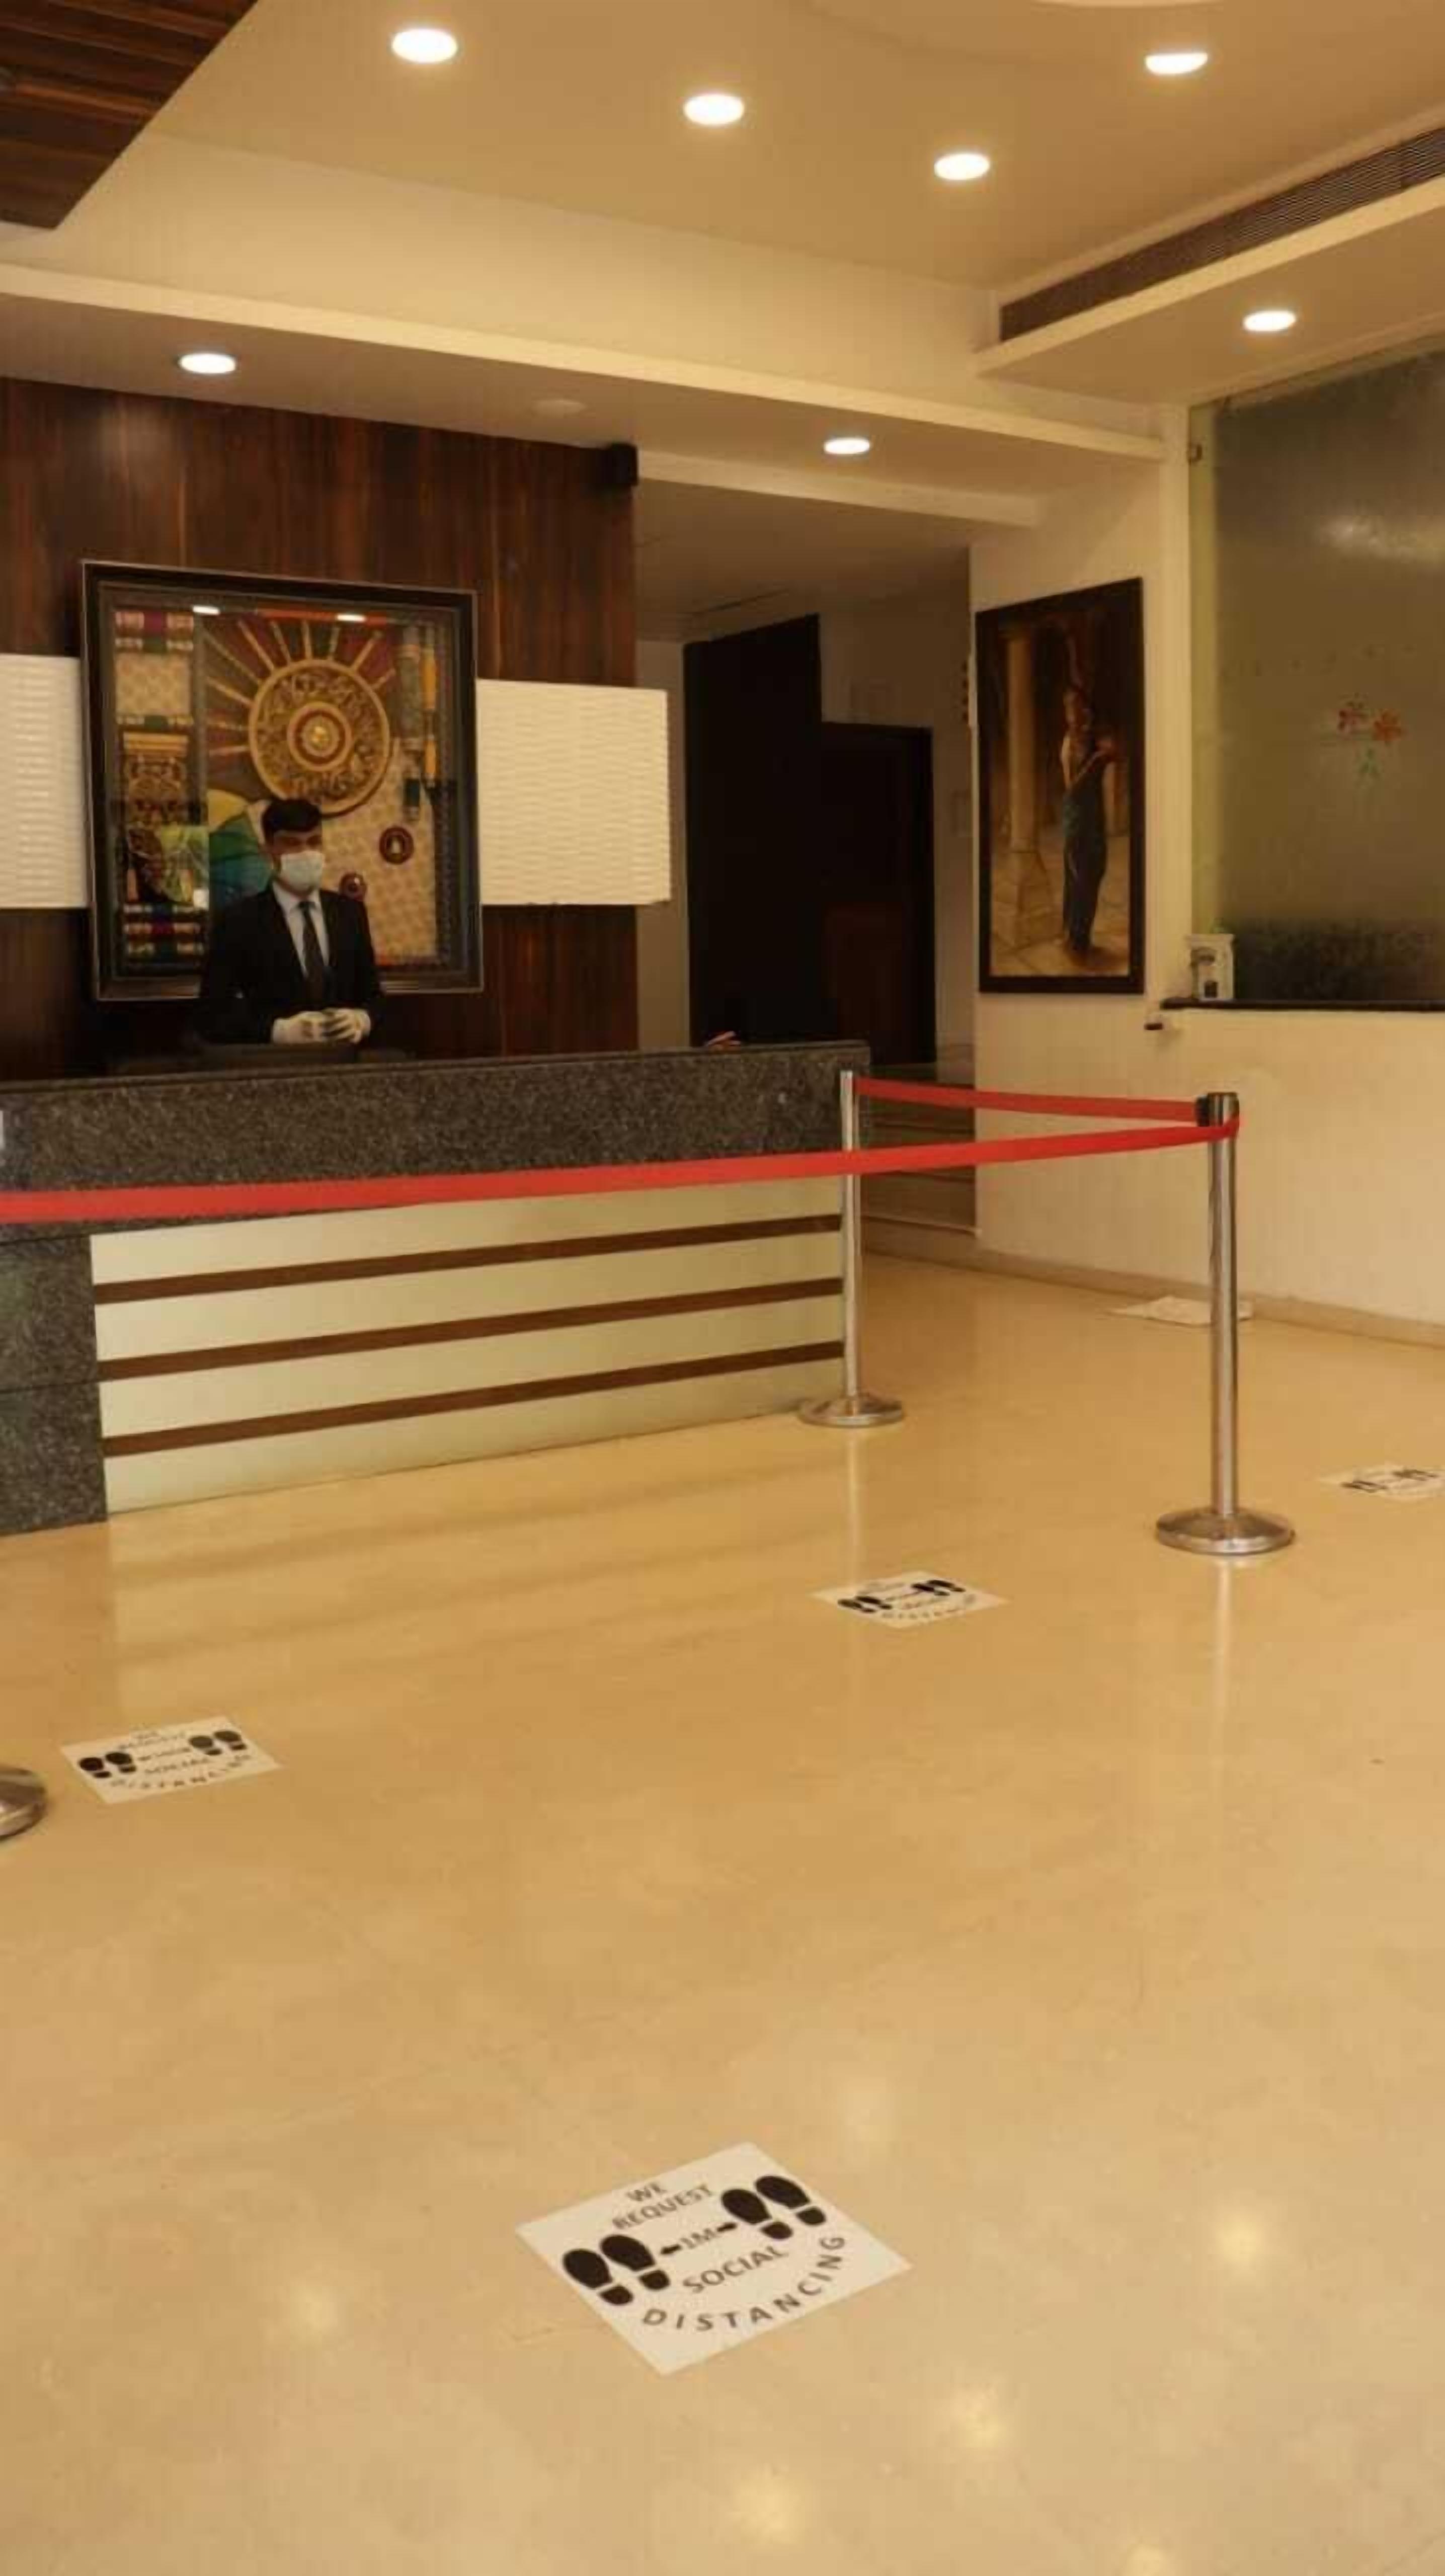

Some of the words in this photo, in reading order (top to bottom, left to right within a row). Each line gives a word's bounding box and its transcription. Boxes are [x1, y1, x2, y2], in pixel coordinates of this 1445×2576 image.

[612, 2184, 712, 2229] REQUEST
[626, 2183, 667, 2203] WE
[681, 2227, 718, 2249] 1M
[641, 2235, 846, 2331] DISTANCING
[683, 2246, 788, 2293] SOCIAL
